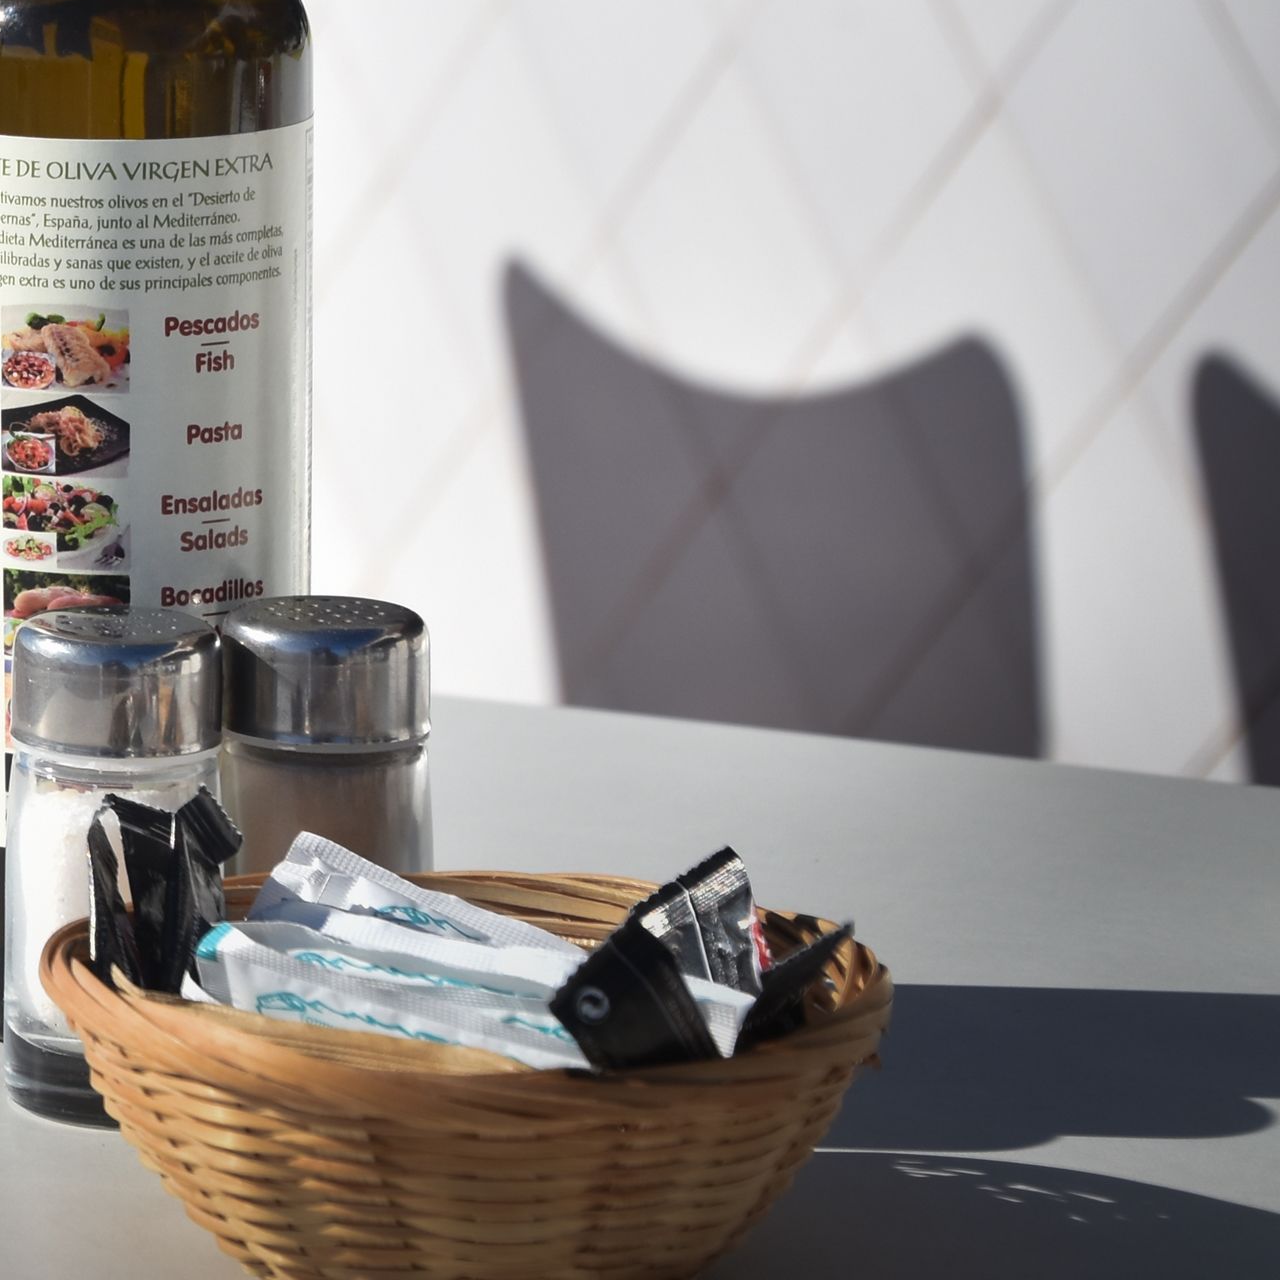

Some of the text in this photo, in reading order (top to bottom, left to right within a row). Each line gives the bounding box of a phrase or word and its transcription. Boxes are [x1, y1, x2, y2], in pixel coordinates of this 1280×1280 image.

[16, 159, 41, 178] DE
[46, 161, 118, 181] OLIVA
[122, 159, 209, 183] VIRGEN
[215, 152, 274, 176] EXTRA
[51, 195, 104, 209] nuestros
[108, 194, 149, 209] olivos
[152, 197, 168, 208] en
[172, 193, 184, 207] el
[243, 186, 256, 202] de
[43, 213, 94, 230] España,
[96, 215, 132, 231] junto
[136, 214, 149, 229] al
[153, 211, 241, 229] Mediterráneo.
[29, 233, 118, 250] Mediterránea
[122, 238, 136, 250] es
[140, 238, 165, 249] una
[169, 234, 185, 248] de
[189, 233, 206, 248] las
[209, 231, 233, 246] más
[236, 225, 284, 243] completas,
[53, 258, 63, 271] y
[66, 257, 104, 270] sanas
[107, 258, 132, 273] que
[135, 256, 184, 270] existen,
[187, 257, 196, 271] y
[199, 252, 210, 267] el
[213, 251, 244, 266] aceite
[247, 247, 260, 262] de
[261, 244, 283, 260] oliva
[19, 275, 49, 288] extra
[52, 277, 66, 289] es
[69, 278, 96, 290] uno
[99, 275, 116, 290] de
[119, 279, 141, 291] sus
[145, 269, 213, 293] principales
[216, 266, 282, 286] componentes.
[164, 310, 260, 337] Pescados
[195, 350, 235, 373] Fish
[186, 421, 243, 445] Pasta
[161, 486, 263, 515] Ensaladas
[180, 525, 249, 552] Salads
